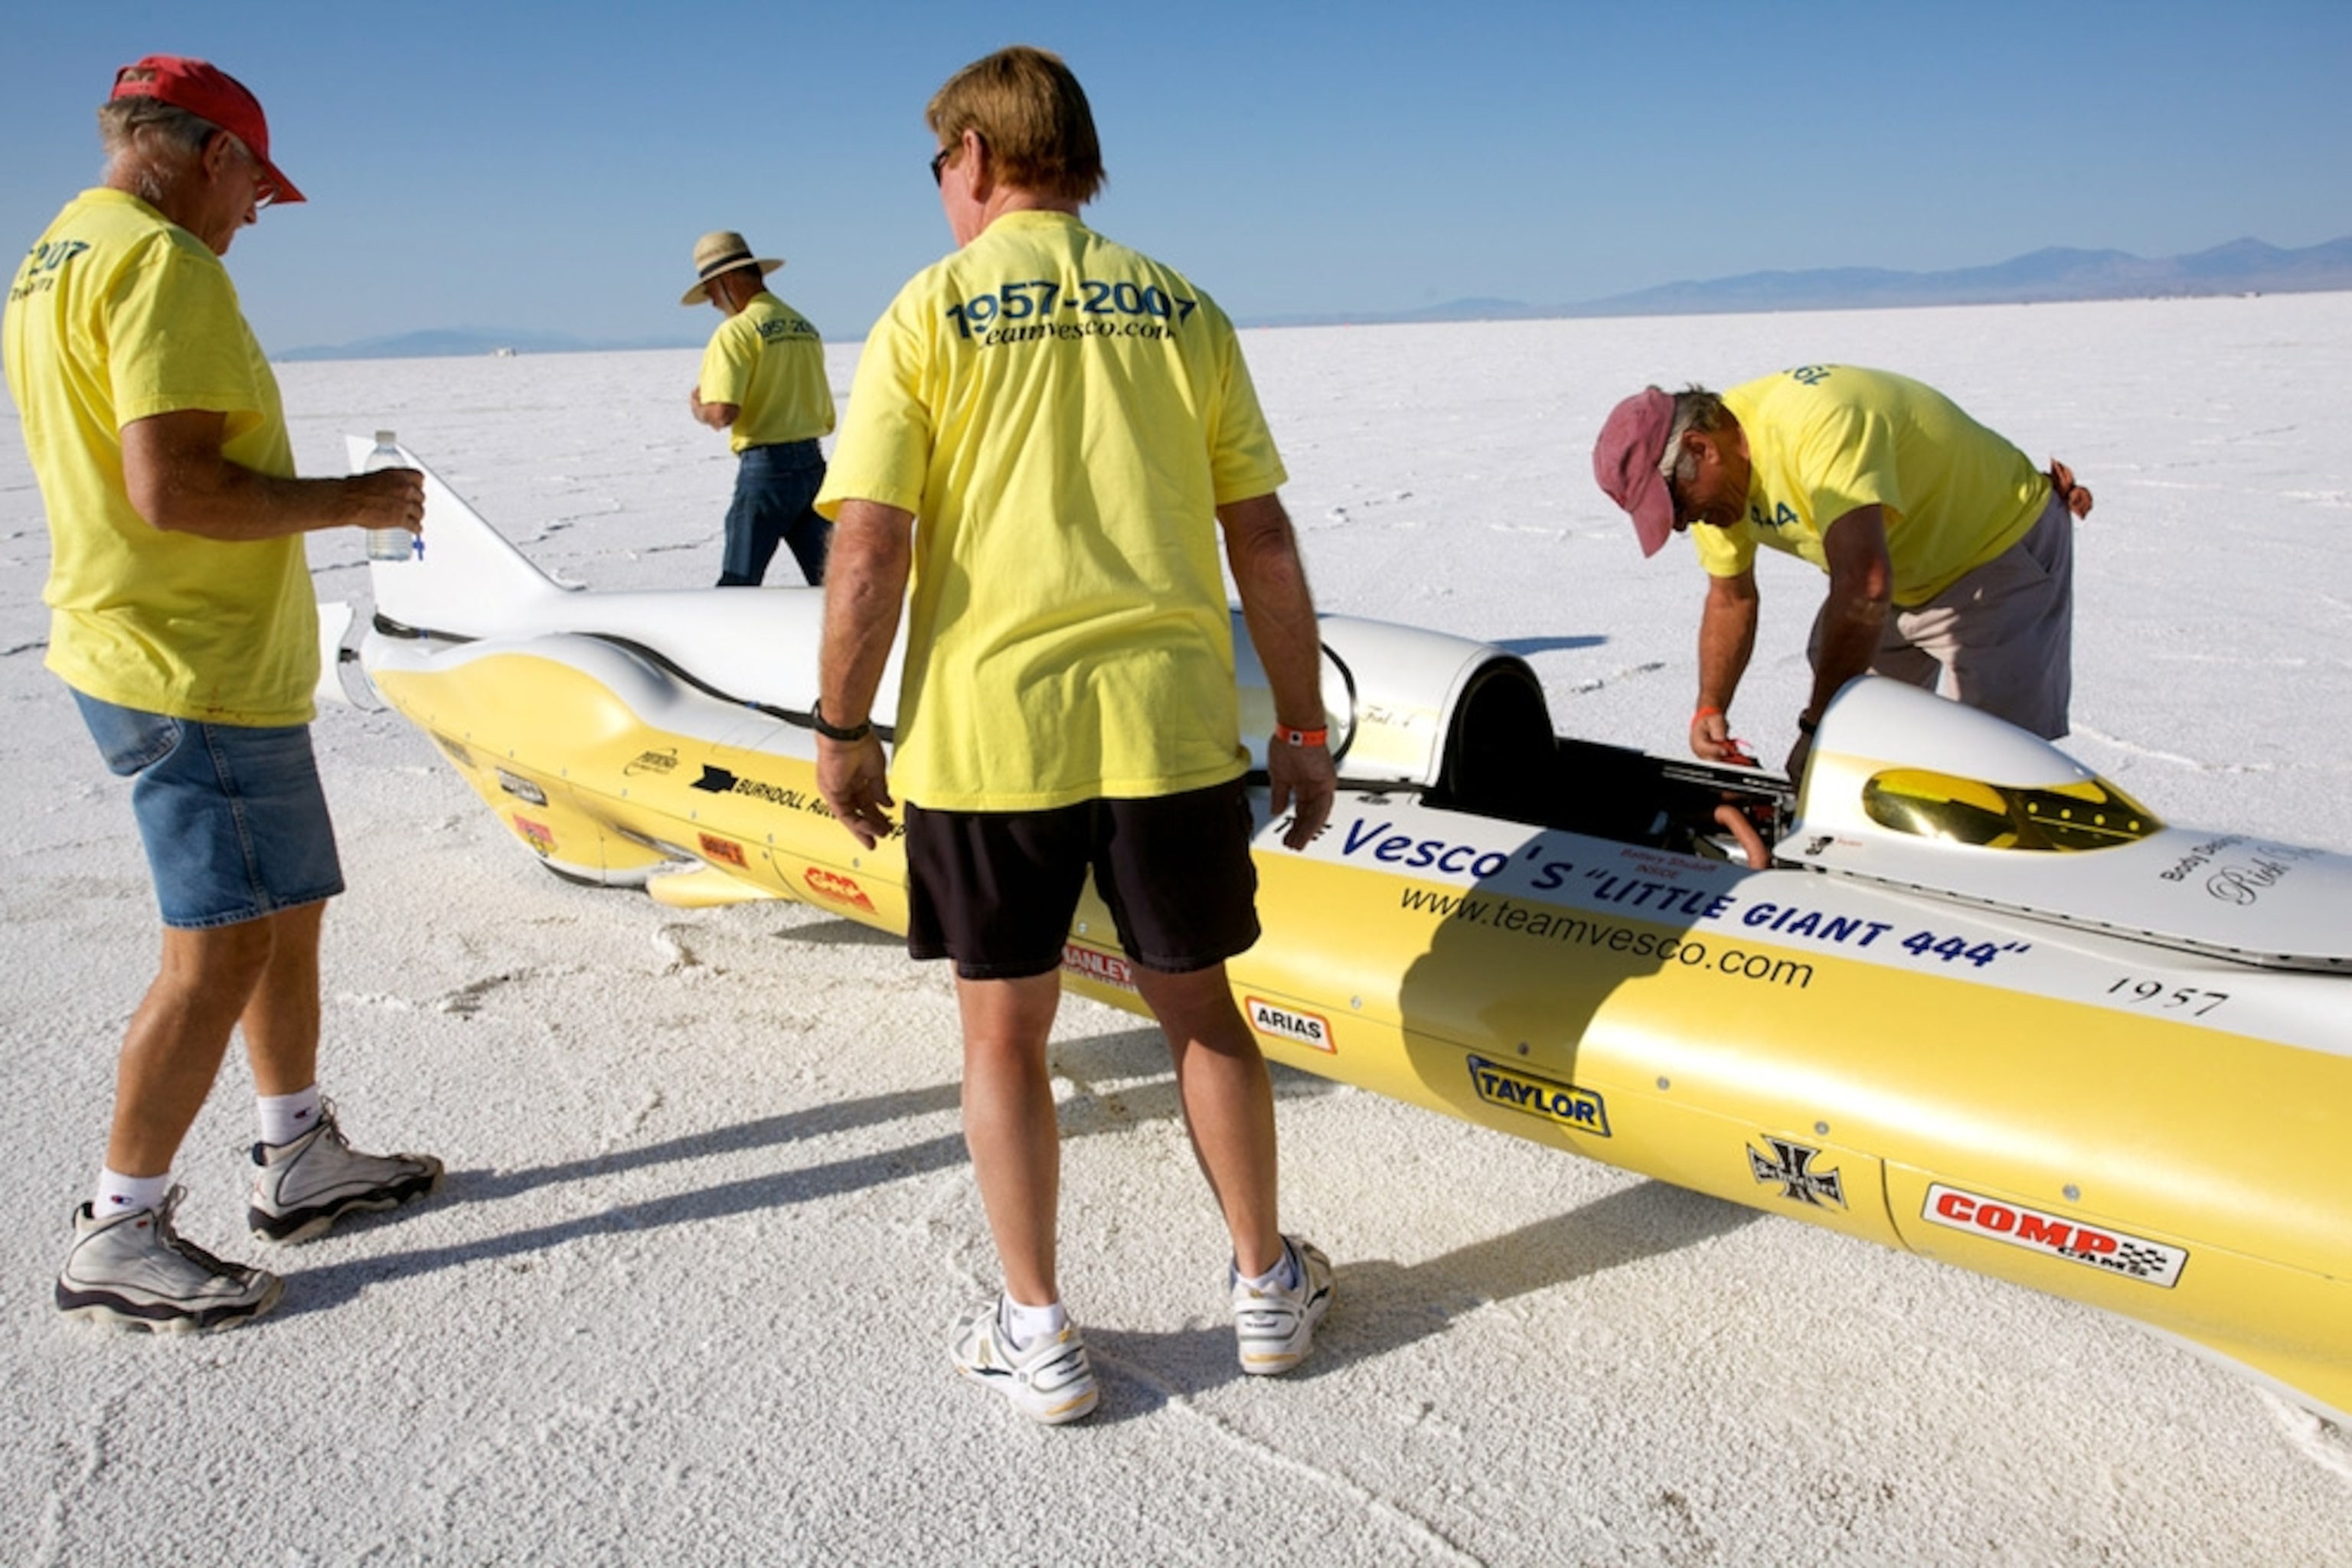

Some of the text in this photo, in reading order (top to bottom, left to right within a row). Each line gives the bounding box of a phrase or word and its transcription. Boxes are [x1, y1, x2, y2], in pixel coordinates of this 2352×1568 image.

[736, 779, 805, 810] BURKDOLL
[1342, 817, 1573, 890] Vesco's
[1743, 903, 1894, 947] GIANT
[1401, 887, 1814, 988] www.teamvesco.com
[2107, 977, 2230, 1018] 1957
[1257, 1007, 1322, 1039] ARIAS
[1480, 1072, 1596, 1126] TAYLOR
[1937, 1193, 2118, 1254] COMP
[2057, 1245, 2149, 1277] CAMS
